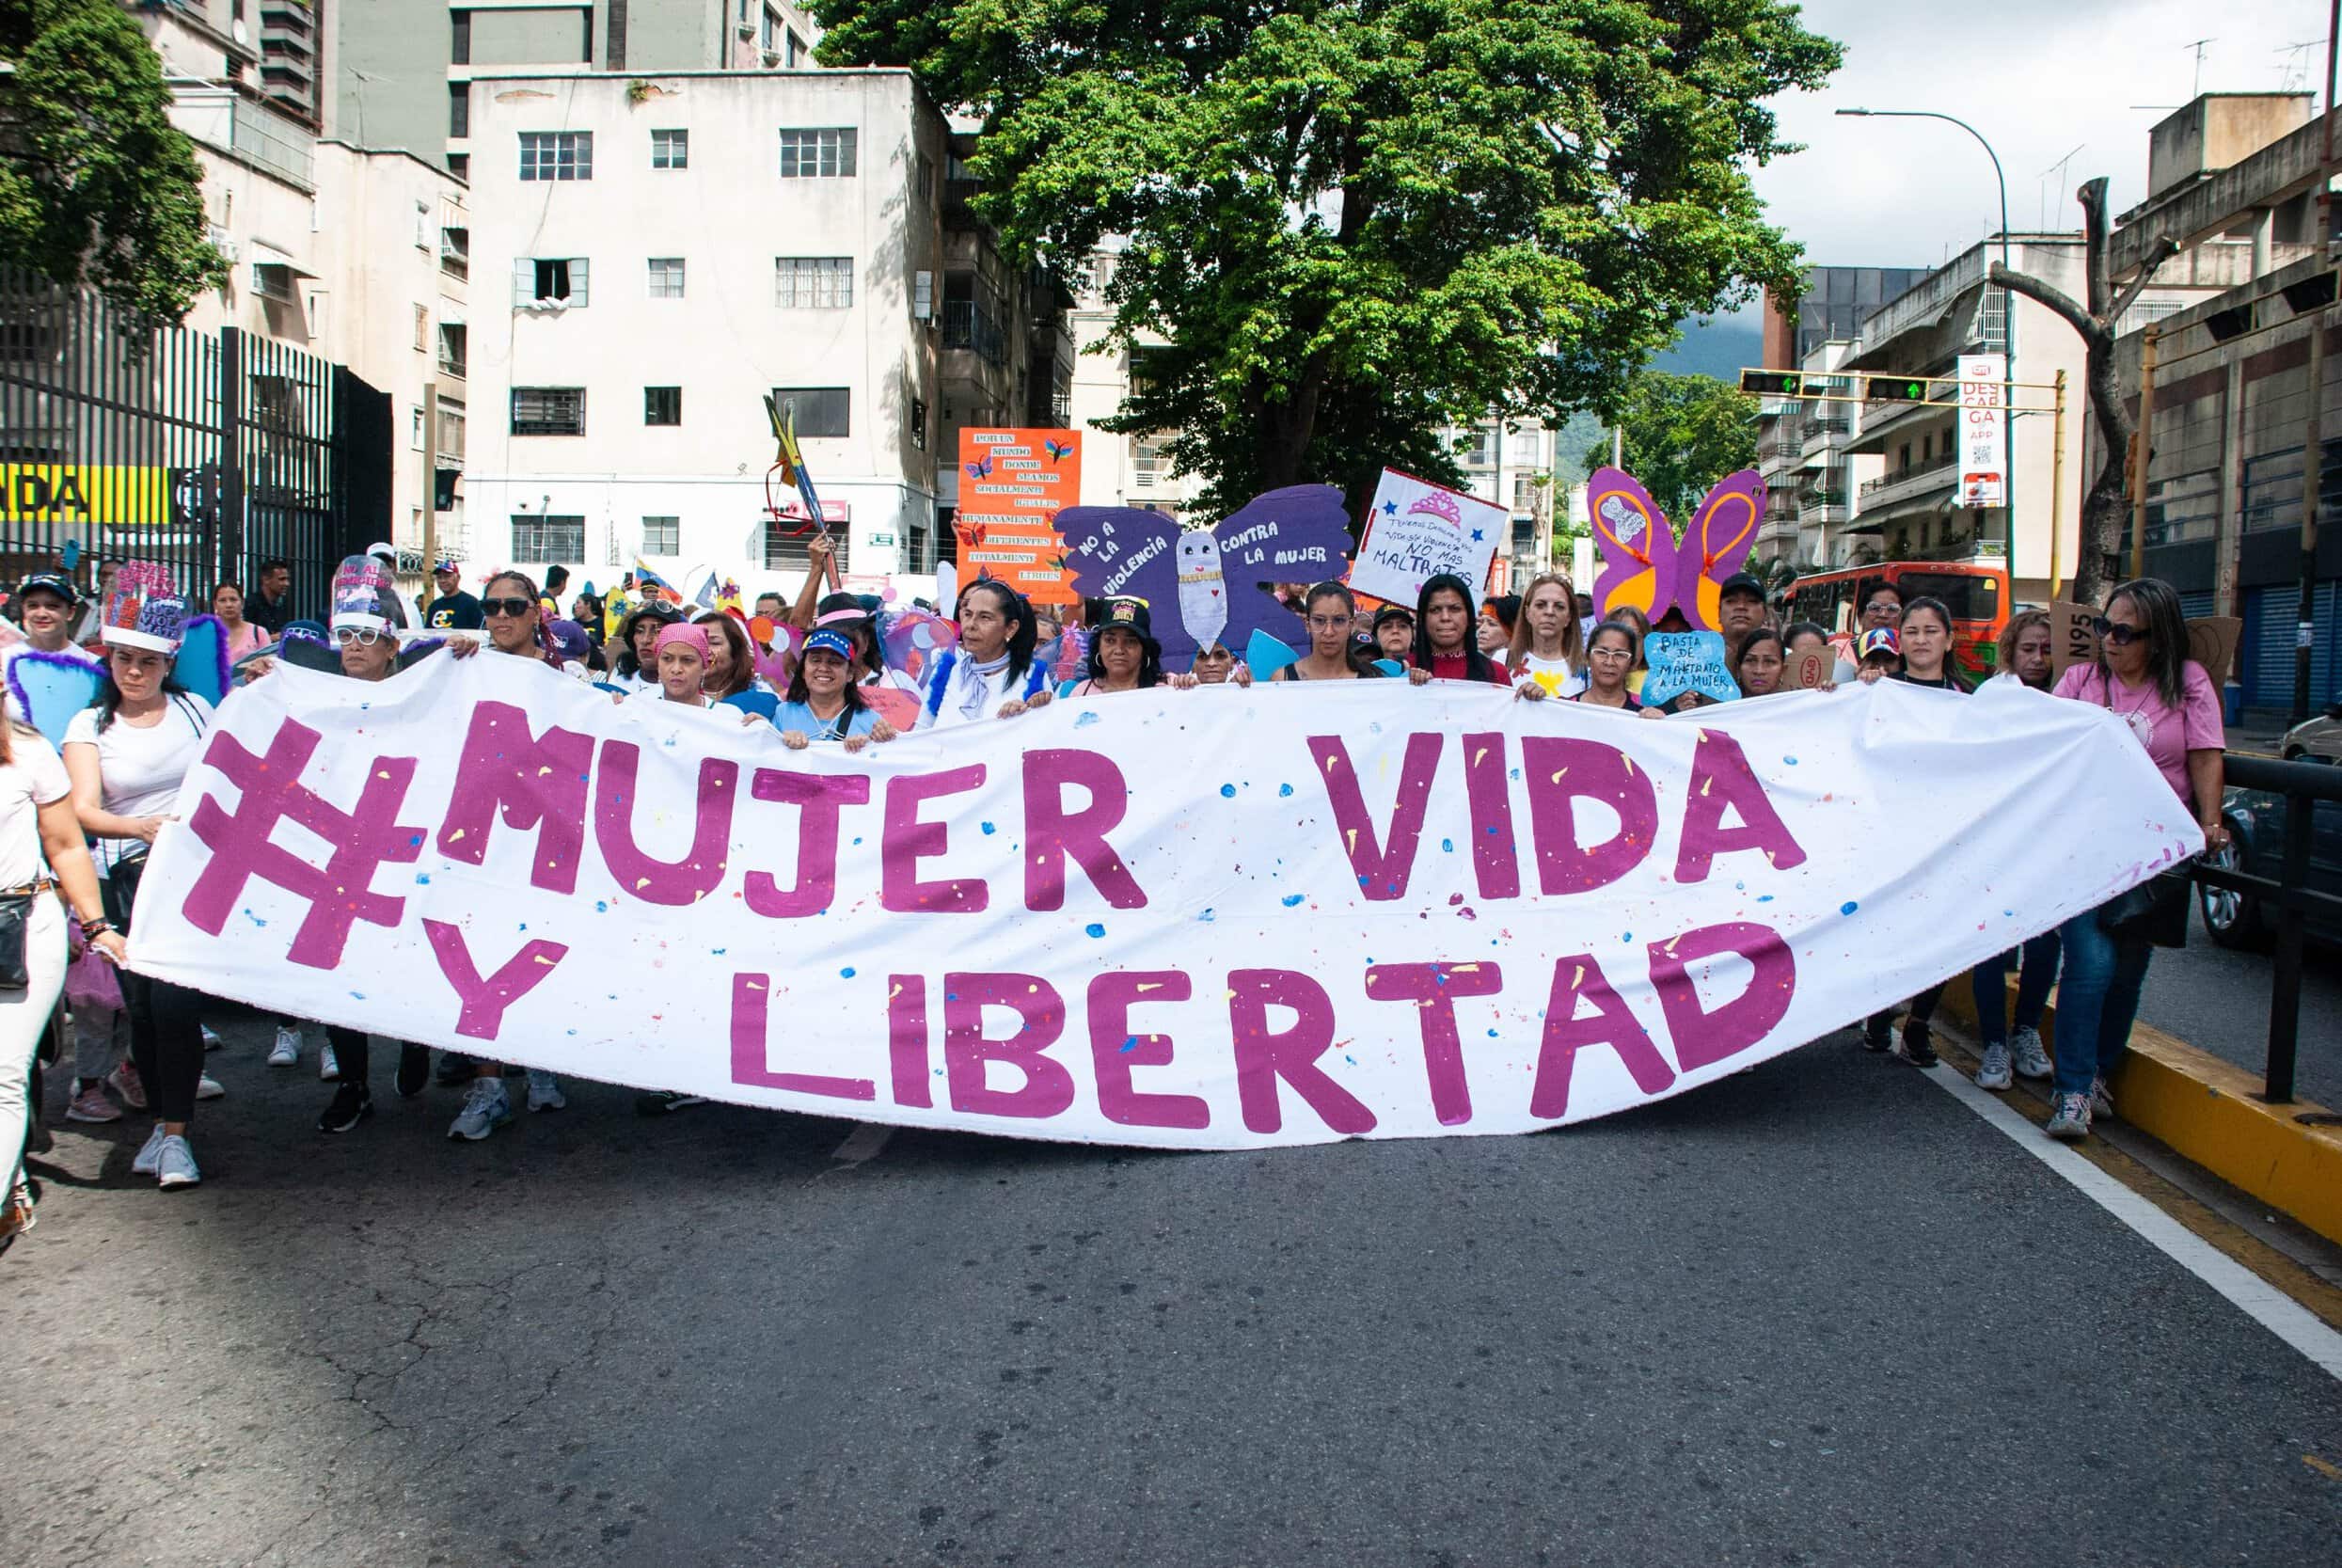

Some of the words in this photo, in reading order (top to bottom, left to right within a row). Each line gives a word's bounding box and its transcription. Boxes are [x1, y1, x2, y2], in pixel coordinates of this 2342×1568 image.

[1970, 410, 1994, 423] GA
[1970, 431, 1993, 440] APP
[992, 448, 1031, 457] MUNDO
[1005, 460, 1040, 469] DONDE
[1017, 473, 1059, 482] SEAMOS
[0, 474, 90, 513] DA
[975, 485, 1043, 494] SOCIALMENTE
[1016, 499, 1059, 508] IGUALES
[962, 515, 1041, 525] HUMANAMENTE
[985, 535, 1050, 546] DIFERENTES
[1079, 536, 1099, 557] NO
[1102, 521, 1116, 536] A
[1221, 521, 1279, 553] CONTRA
[970, 552, 1036, 562] TOTALMENTE
[1097, 540, 1120, 562] LA
[1244, 547, 1265, 565] LA
[1274, 546, 1327, 565] MUJER
[1405, 542, 1433, 557] NO
[1437, 550, 1464, 565] MAS
[1019, 571, 1060, 580] LIBRES
[2069, 613, 2093, 658] N95
[1661, 636, 1701, 649] BASTA
[1677, 647, 1694, 657] DE
[1672, 676, 1686, 687] LA
[1691, 675, 1730, 689] MUJER
[182, 700, 1148, 969] #MUJER
[1306, 728, 1807, 900] VIDA
[421, 918, 568, 1040] Y
[731, 921, 1796, 1134] LIBERTAD
